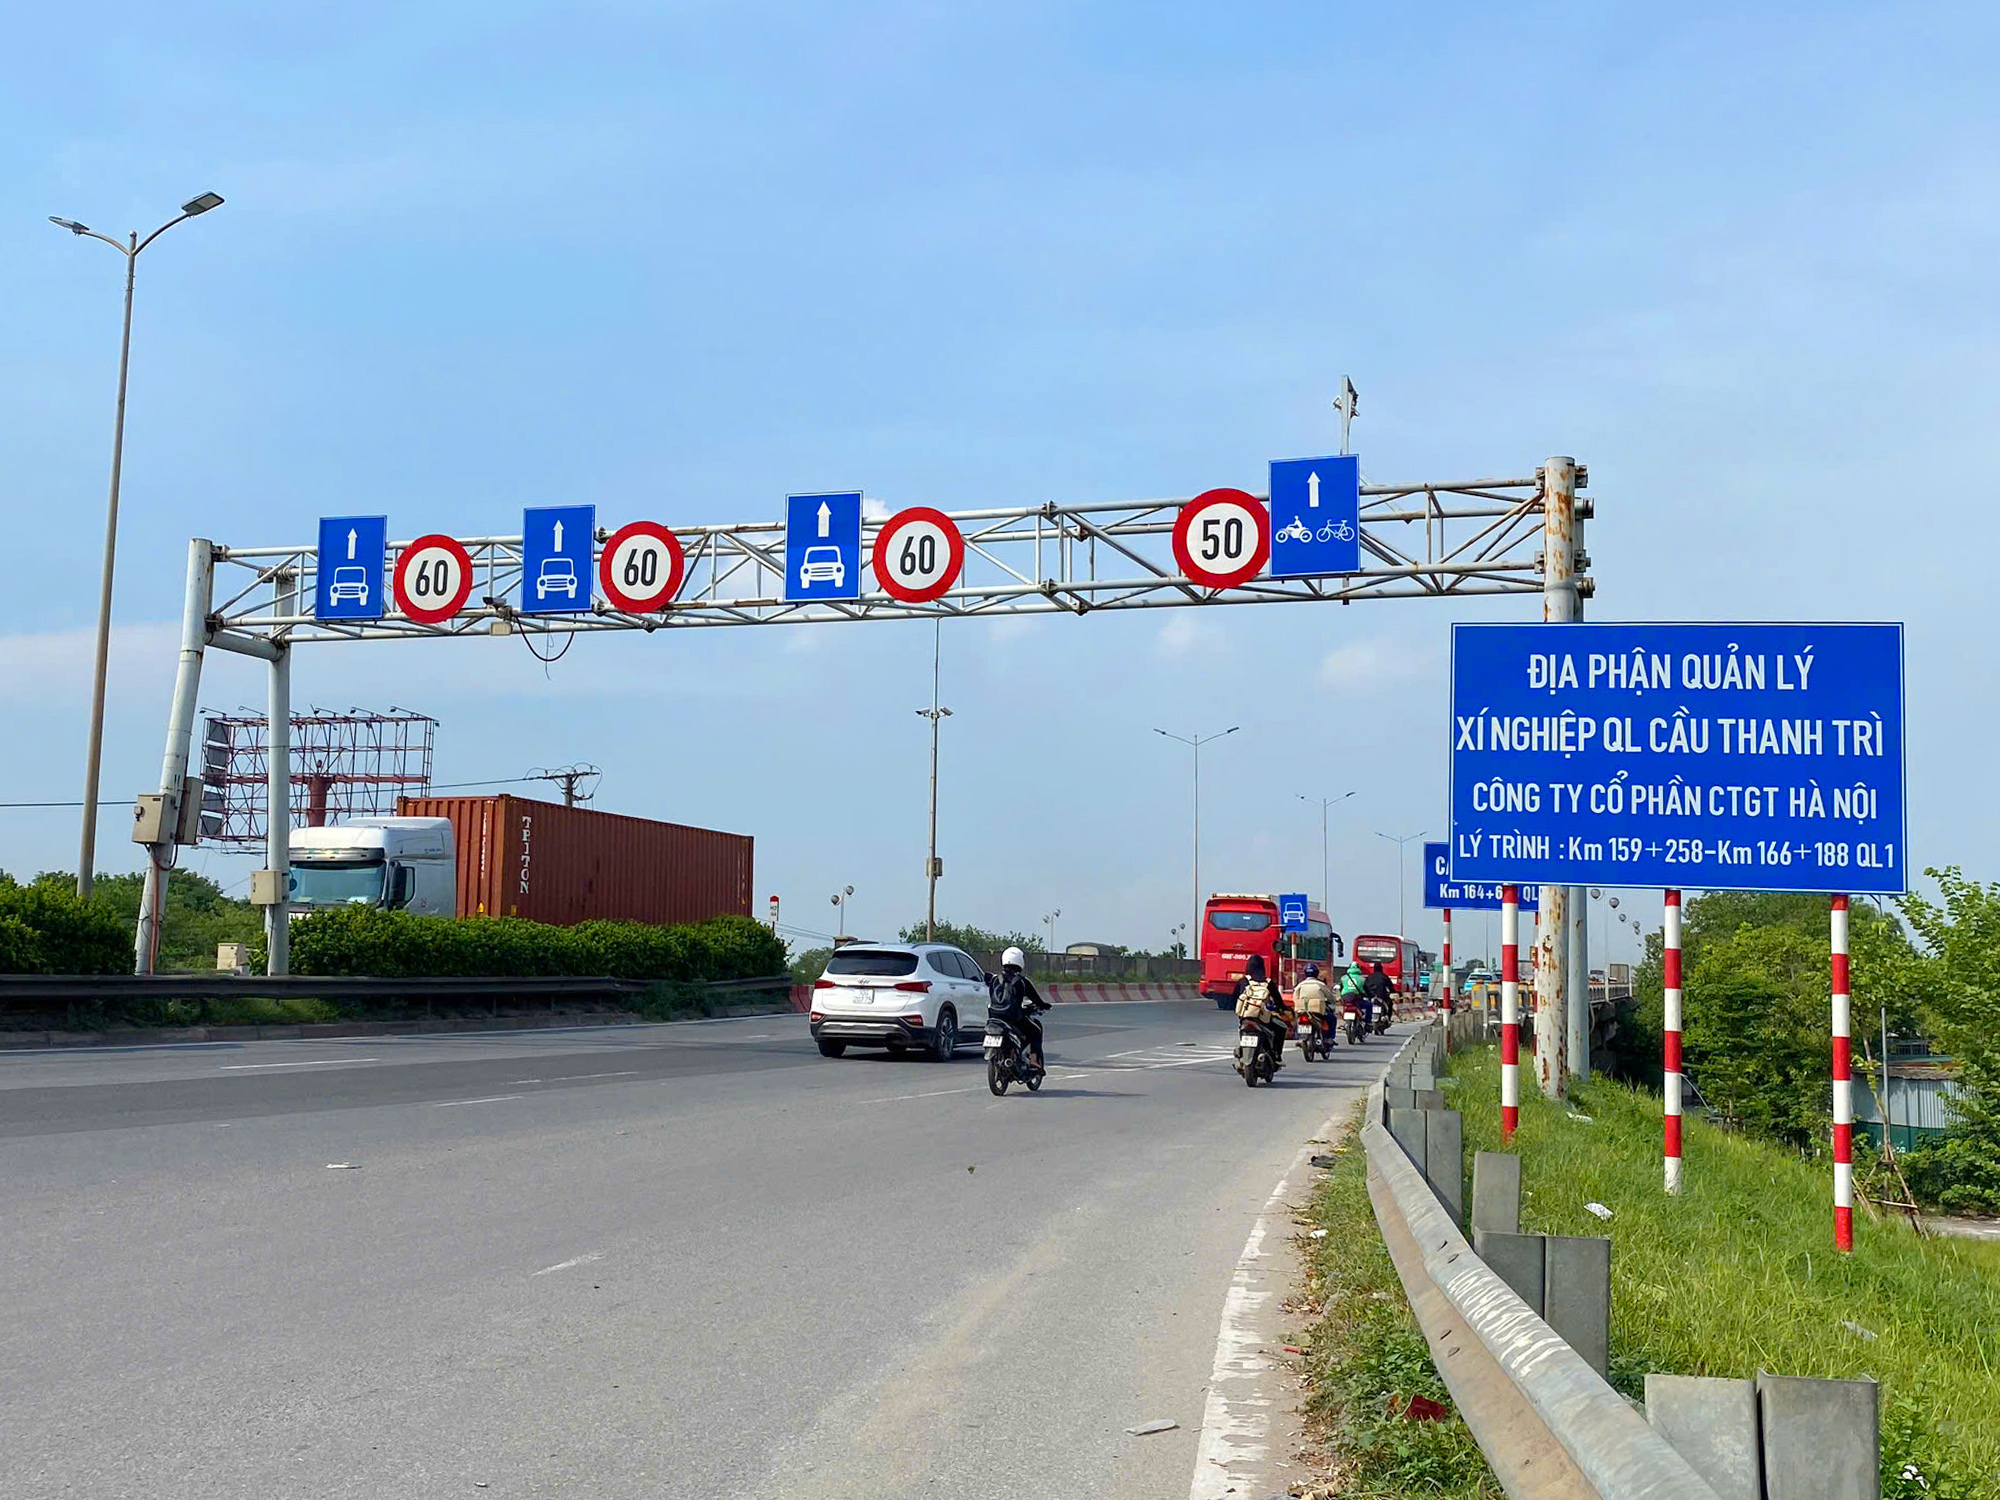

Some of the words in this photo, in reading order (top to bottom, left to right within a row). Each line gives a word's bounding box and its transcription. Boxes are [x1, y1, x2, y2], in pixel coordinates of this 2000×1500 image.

[899, 534, 936, 576] 60
[1201, 518, 1243, 561] 50
[415, 559, 449, 597] 60
[623, 548, 658, 587] 60
[1527, 654, 1579, 695] ĐỊA
[1588, 647, 1671, 695] PHẬN
[1681, 642, 1766, 690] QUẢN
[1776, 645, 1815, 690] LÝ
[1456, 707, 1489, 751] XÍ
[1491, 709, 1597, 758] NGHIỆP
[1603, 716, 1642, 753] QL
[1649, 706, 1710, 754] CẦU
[1717, 718, 1823, 756] THANH
[1832, 711, 1884, 757] TRÌ
[1473, 776, 1540, 813] CÔNG
[1549, 783, 1583, 813] TY
[1590, 770, 1630, 814] CỔ
[1631, 775, 1701, 816] PHẦN
[1709, 786, 1779, 817] CTGT
[1789, 780, 1826, 818] HÀ
[1833, 782, 1877, 825] NỘI
[1459, 829, 1483, 859] LÝ
[1488, 829, 1550, 859] TRÌNH
[1856, 843, 1893, 868] QL1
[1439, 883, 1460, 898] Km
